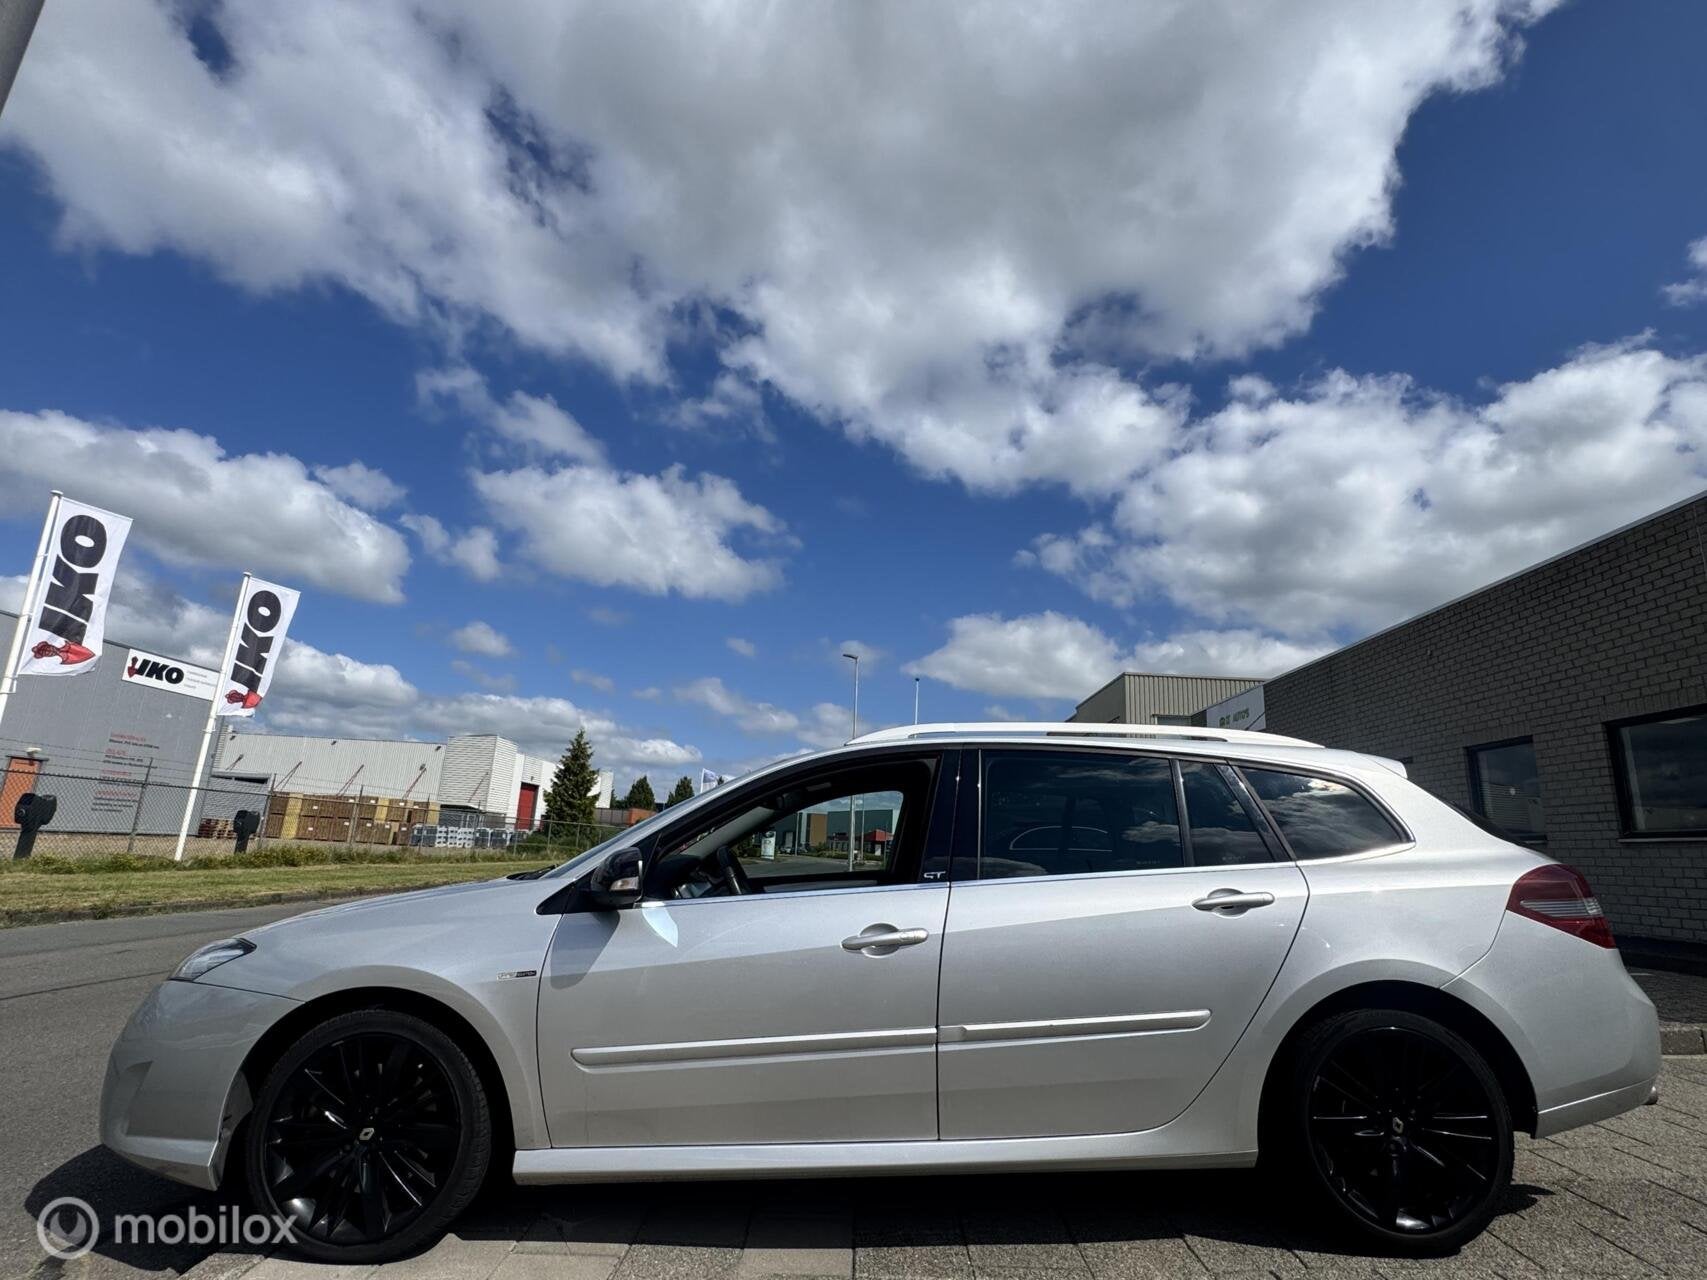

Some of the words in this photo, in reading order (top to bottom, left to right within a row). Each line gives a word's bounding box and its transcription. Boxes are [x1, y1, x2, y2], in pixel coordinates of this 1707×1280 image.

[38, 514, 108, 645] IKO
[136, 658, 185, 685] IKO
[230, 590, 282, 692] IKO
